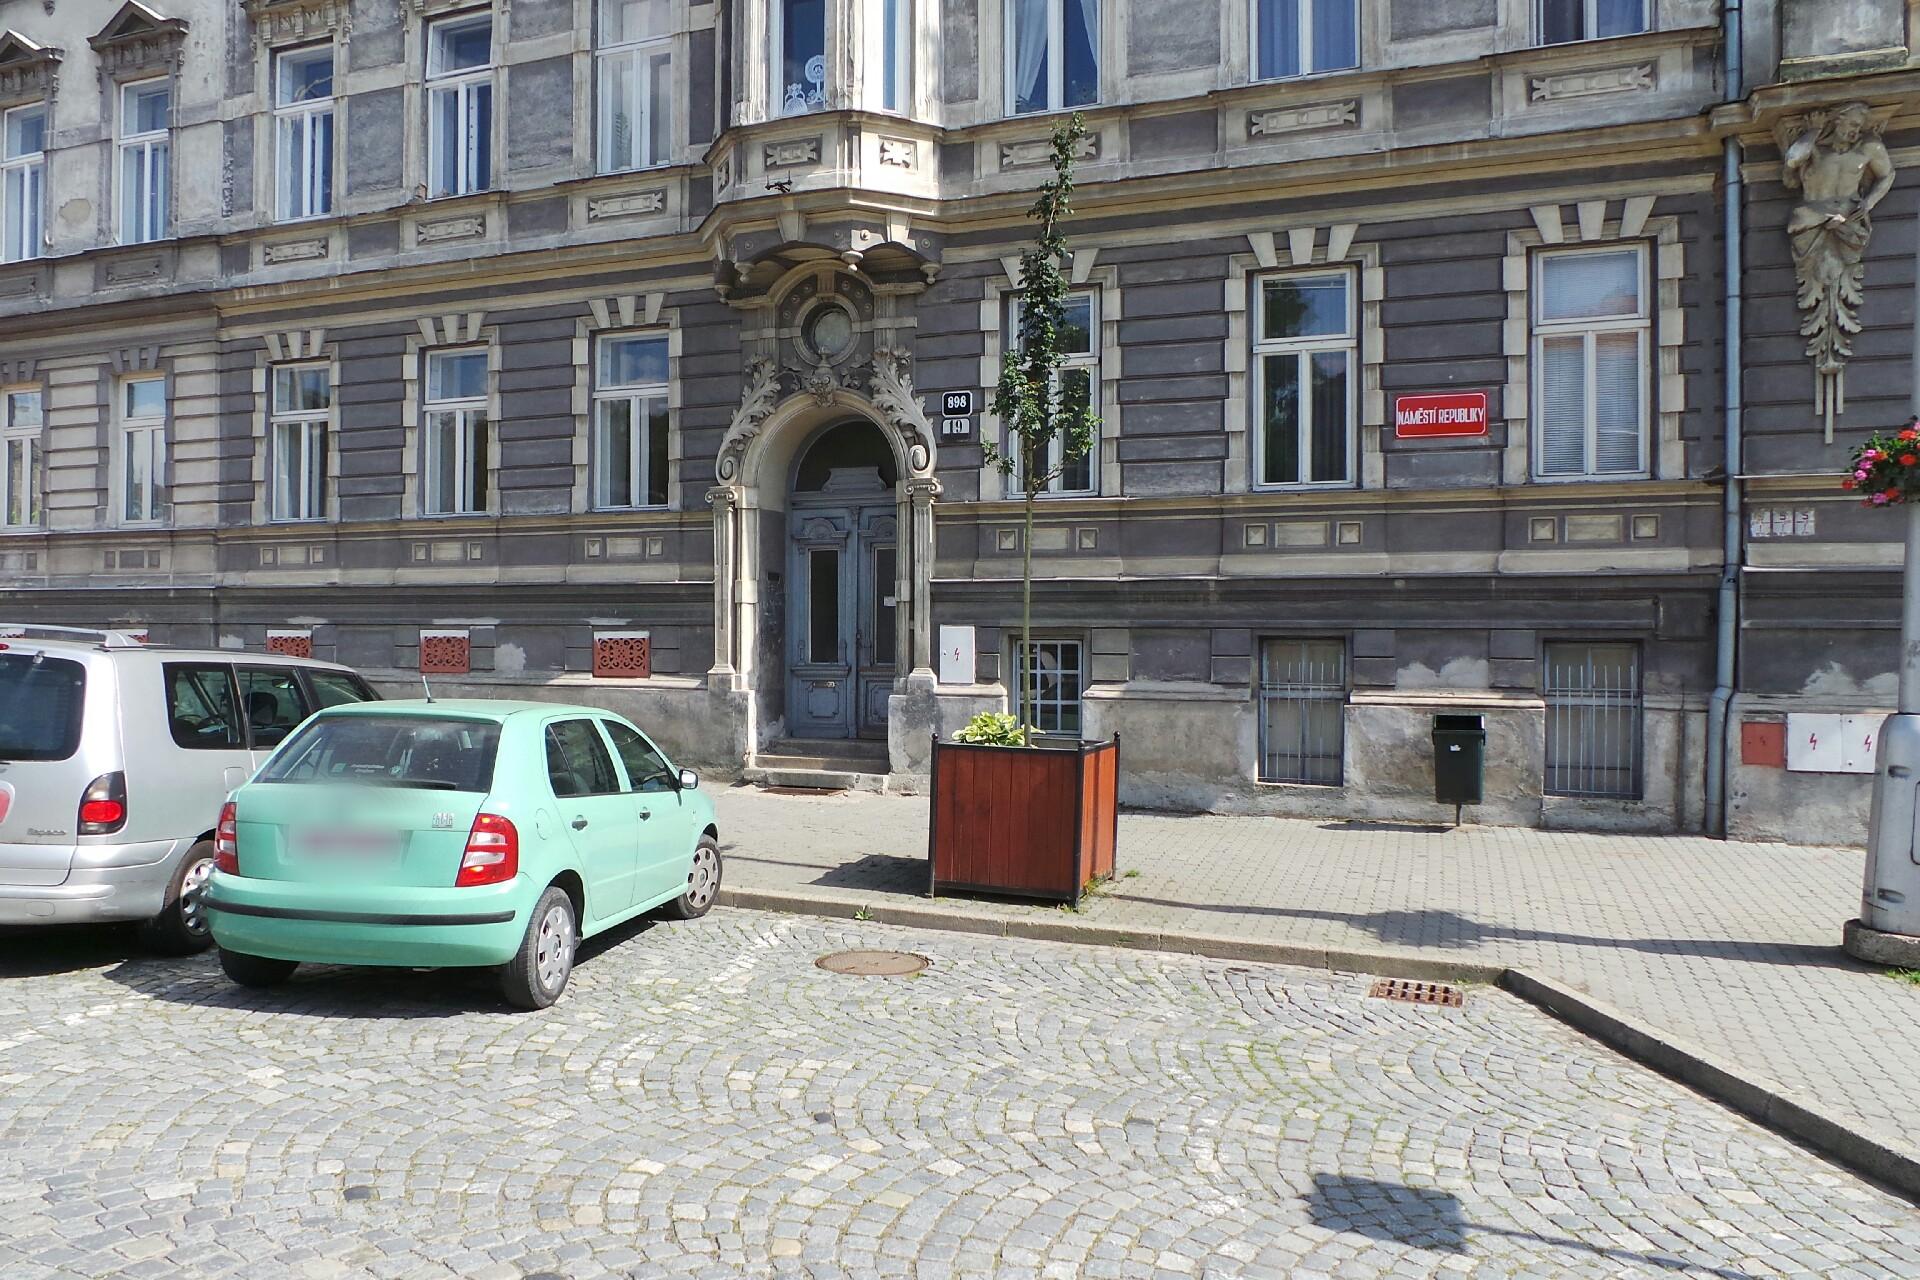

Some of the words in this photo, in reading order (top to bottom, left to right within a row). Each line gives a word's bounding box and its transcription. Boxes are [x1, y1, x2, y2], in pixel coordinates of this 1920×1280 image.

[947, 395, 967, 408] 898
[1398, 407, 1438, 425] NÁMĚSTÍ
[1438, 408, 1484, 424] REPUBLIKY
[949, 419, 963, 433] 19
